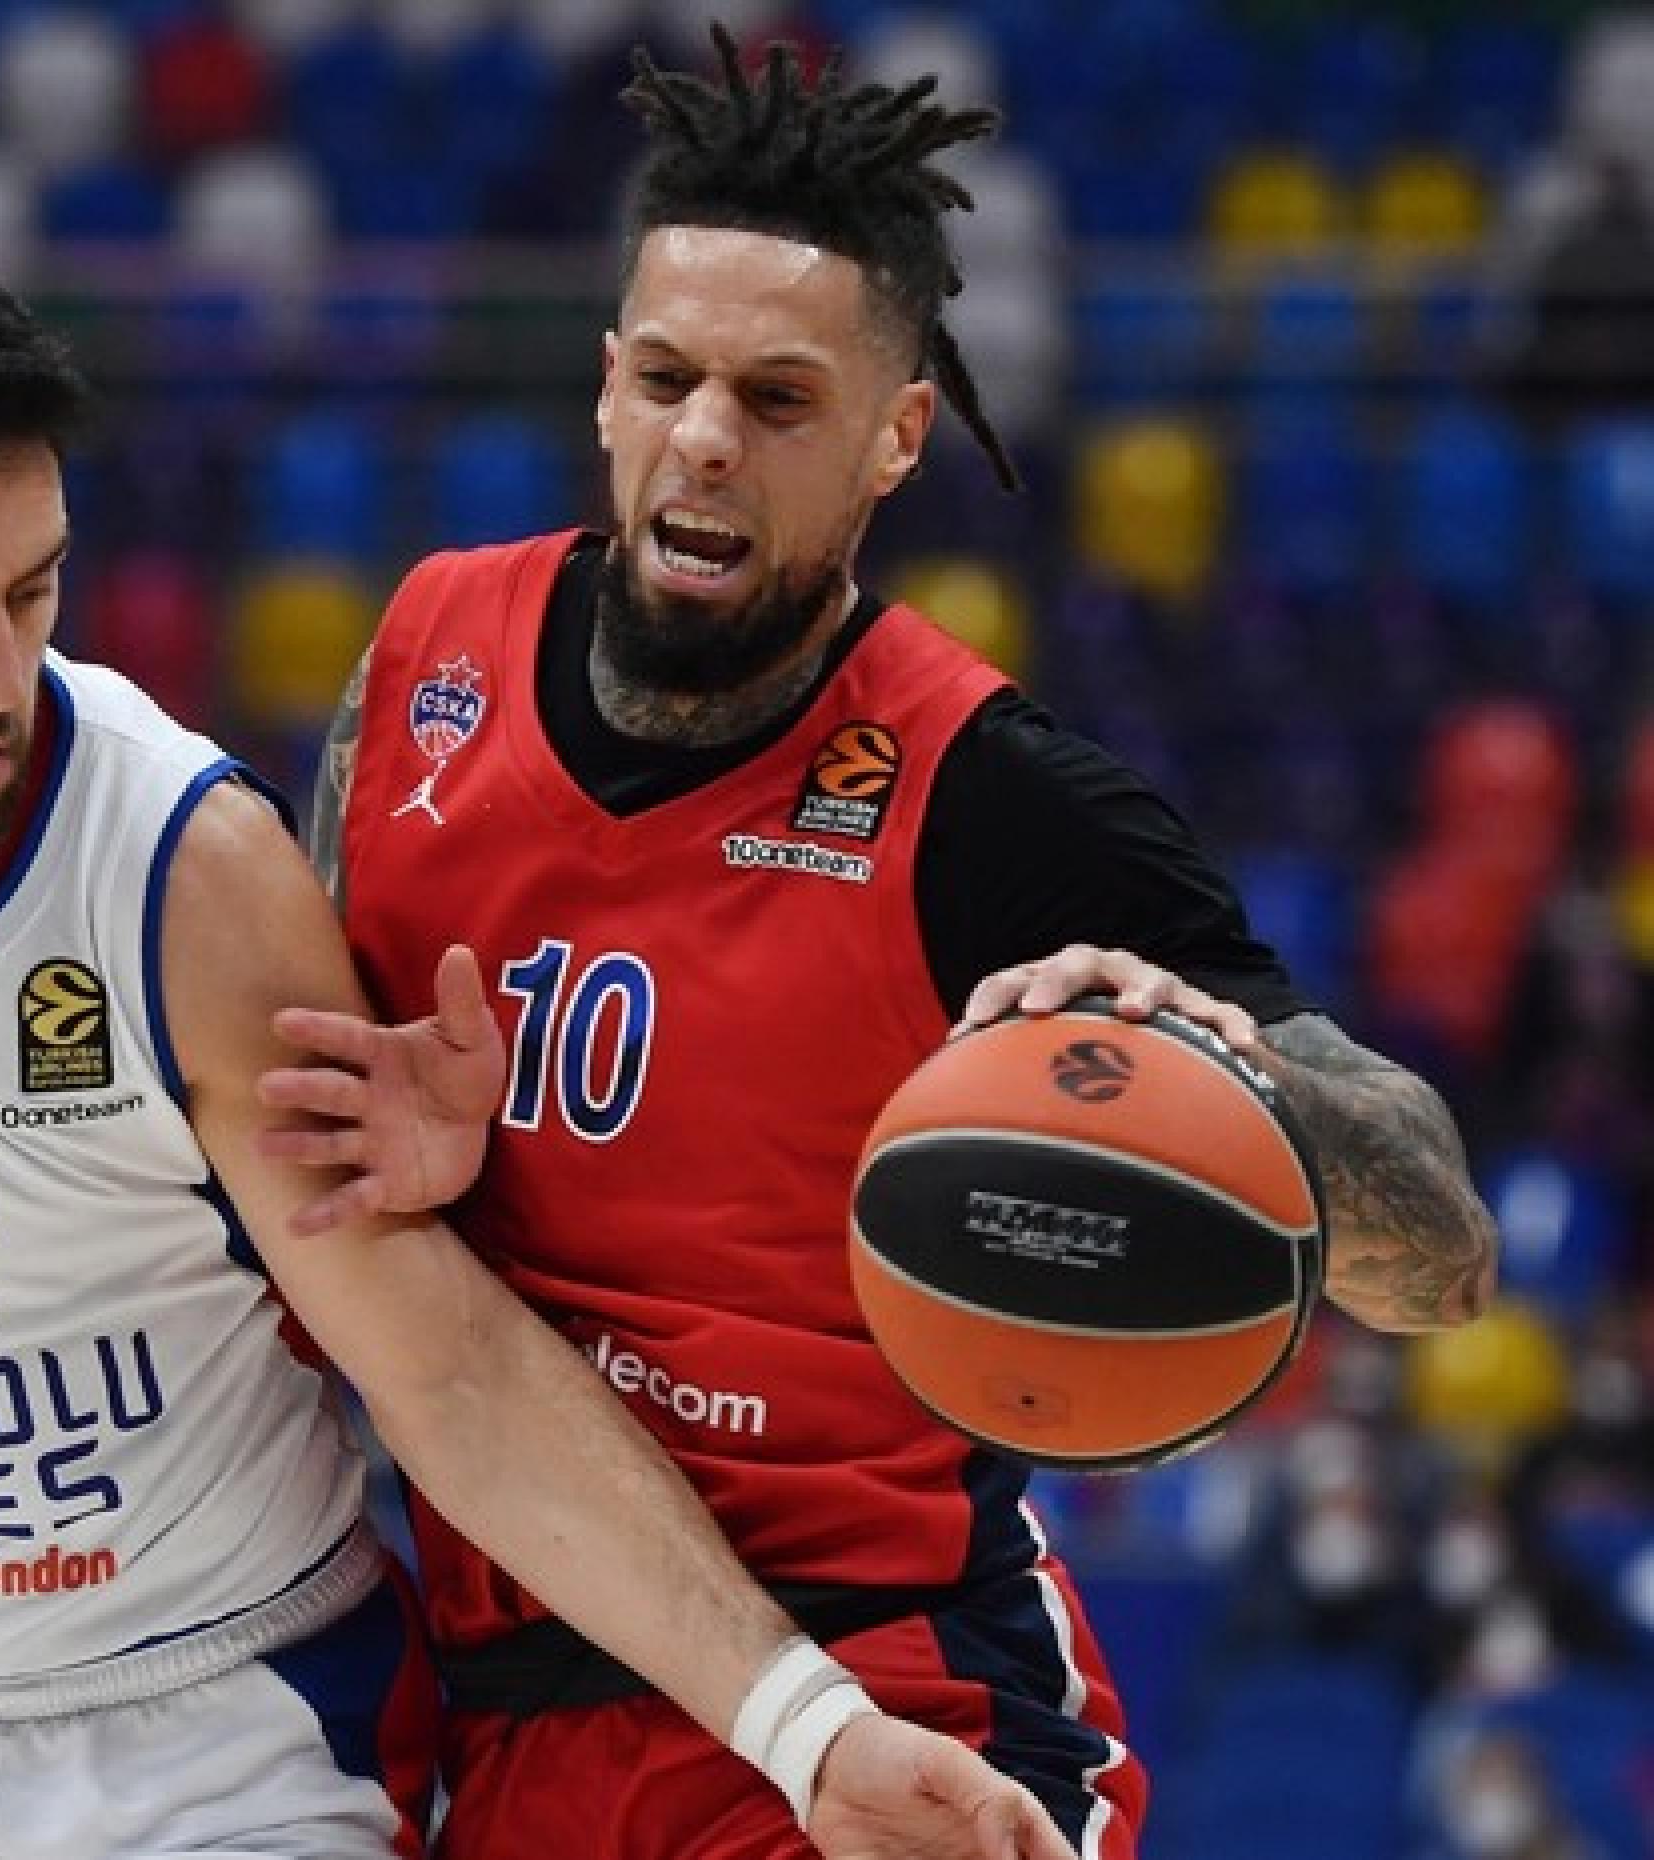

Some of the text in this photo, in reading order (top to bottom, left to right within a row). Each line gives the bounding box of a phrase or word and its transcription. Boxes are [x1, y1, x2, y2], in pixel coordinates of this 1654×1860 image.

[420, 691, 476, 720] CSKA
[499, 939, 655, 1141] 10
[586, 1331, 768, 1437] lecom
